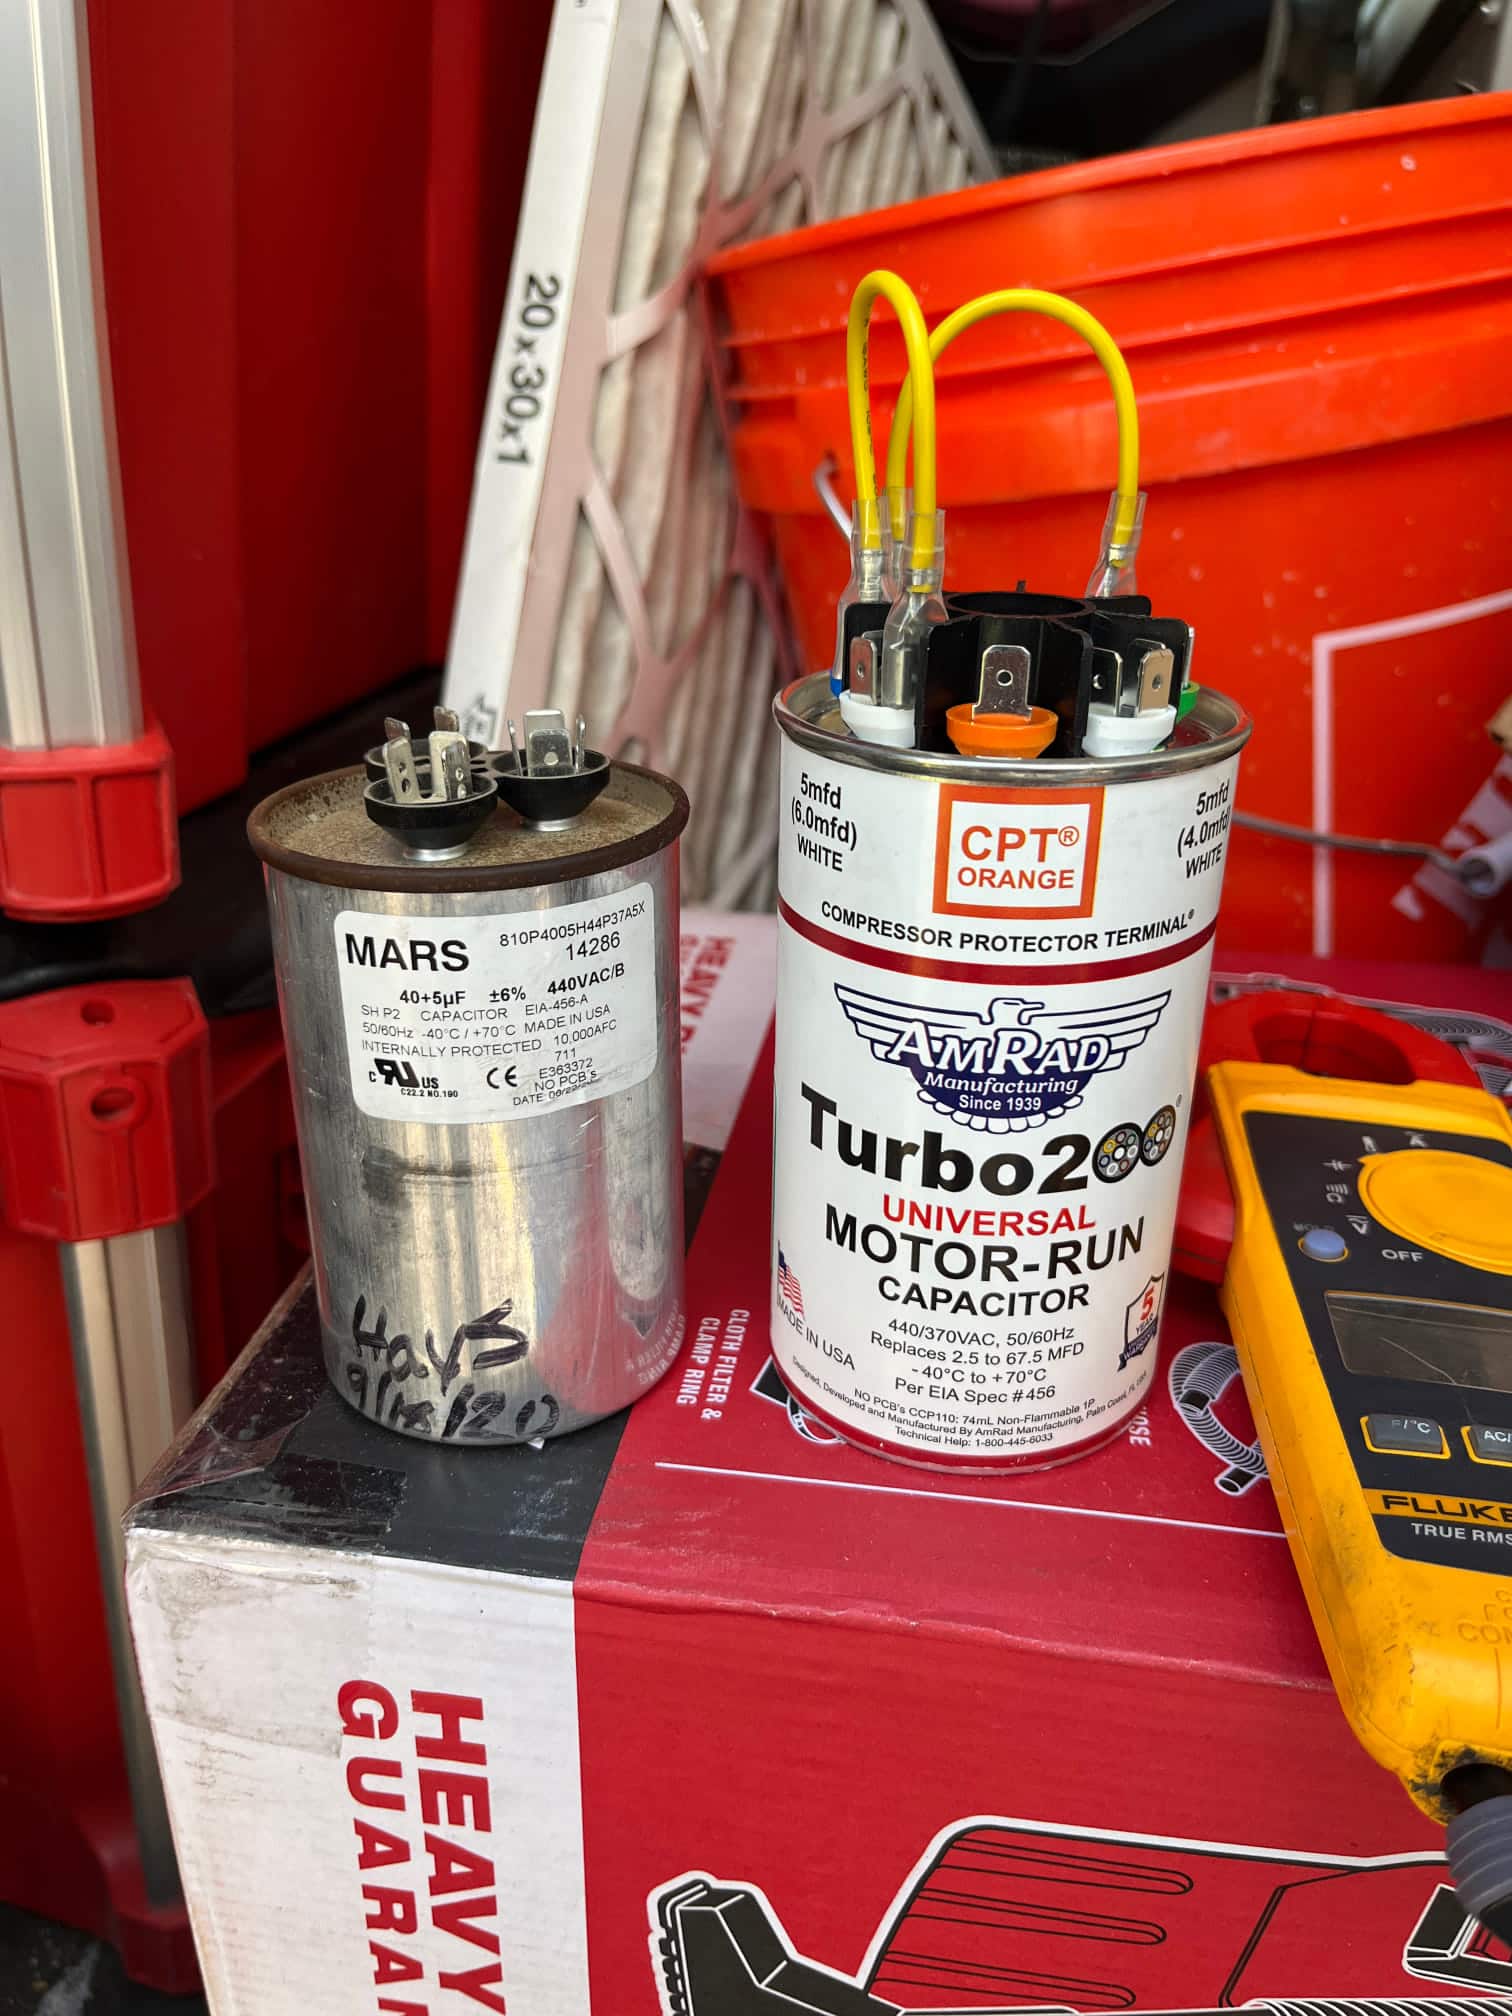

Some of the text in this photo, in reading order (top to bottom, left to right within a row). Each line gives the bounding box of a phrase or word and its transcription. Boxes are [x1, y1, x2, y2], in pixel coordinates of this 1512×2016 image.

[800, 772, 842, 810] 5mfd
[1196, 777, 1230, 815] 5mfd
[792, 795, 857, 851] (6.0mfd)
[797, 832, 843, 872] WHITE
[1185, 842, 1223, 878] WHITE
[957, 867, 1075, 890] ORANGE
[499, 902, 646, 947] 810P4005H44P37A5X
[821, 901, 952, 948] COMPRESSOR
[959, 931, 1098, 953] PROTECTOR
[345, 932, 470, 972] MARS
[566, 931, 621, 961] 14286
[489, 986, 526, 1002] ±6%
[547, 962, 625, 995] 440VAC/B
[361, 994, 588, 1021] SH P2 CAPACITOR EIA-456-A
[362, 1022, 414, 1038] 50/60Hz
[421, 1028, 460, 1040] -40°C
[473, 1024, 516, 1038] +70°C
[525, 1016, 566, 1034] MADE
[570, 1013, 582, 1025] IN
[586, 1004, 610, 1020] USA
[362, 1040, 446, 1057] INTERNALLY
[451, 1039, 542, 1056] PROTECTED
[554, 1048, 576, 1062] 711
[534, 1080, 556, 1092] NO
[539, 1058, 593, 1079] E363372
[923, 1070, 1078, 1094] Manufacturing
[958, 1094, 1042, 1112] Since 1939
[883, 1194, 1097, 1236] UNIVERSAL
[825, 1203, 1145, 1282] MOTOR-RUN
[1381, 1249, 1423, 1262] OFF
[878, 1275, 1090, 1317] CAPACITOR
[1140, 1286, 1154, 1321] 5
[777, 1294, 856, 1371] MADE IN USA
[870, 1331, 1085, 1365] Replaces 2.5 to 67.5 MFD
[888, 1319, 1075, 1348] 440/370VAC, 50/60Hz
[676, 1317, 721, 1405] CLAMP RING
[700, 1309, 750, 1420] CLOTH FILTER &
[971, 1371, 986, 1384] to
[823, 1381, 866, 1411] Developed
[868, 1405, 885, 1418] and
[887, 1412, 957, 1434] Manufactured
[960, 1426, 973, 1437] By
[975, 1424, 1013, 1436] AmRad
[1016, 1414, 1085, 1435] Manufacturing,
[1086, 1404, 1106, 1418] Palm
[854, 1387, 871, 1402] NO
[874, 1395, 906, 1414] PCB's
[908, 1408, 959, 1424] CCP110:
[962, 1415, 994, 1426] 74mL
[997, 1405, 1080, 1425] Non-Flammable
[895, 1377, 1056, 1405] Per EIA Spec #456
[895, 1426, 1053, 1447] Technical Help: 1-800-445-6033
[1129, 1406, 1151, 1446] OSE
[1410, 1522, 1467, 1540] TRUE
[410, 1689, 506, 2015] HEAVY
